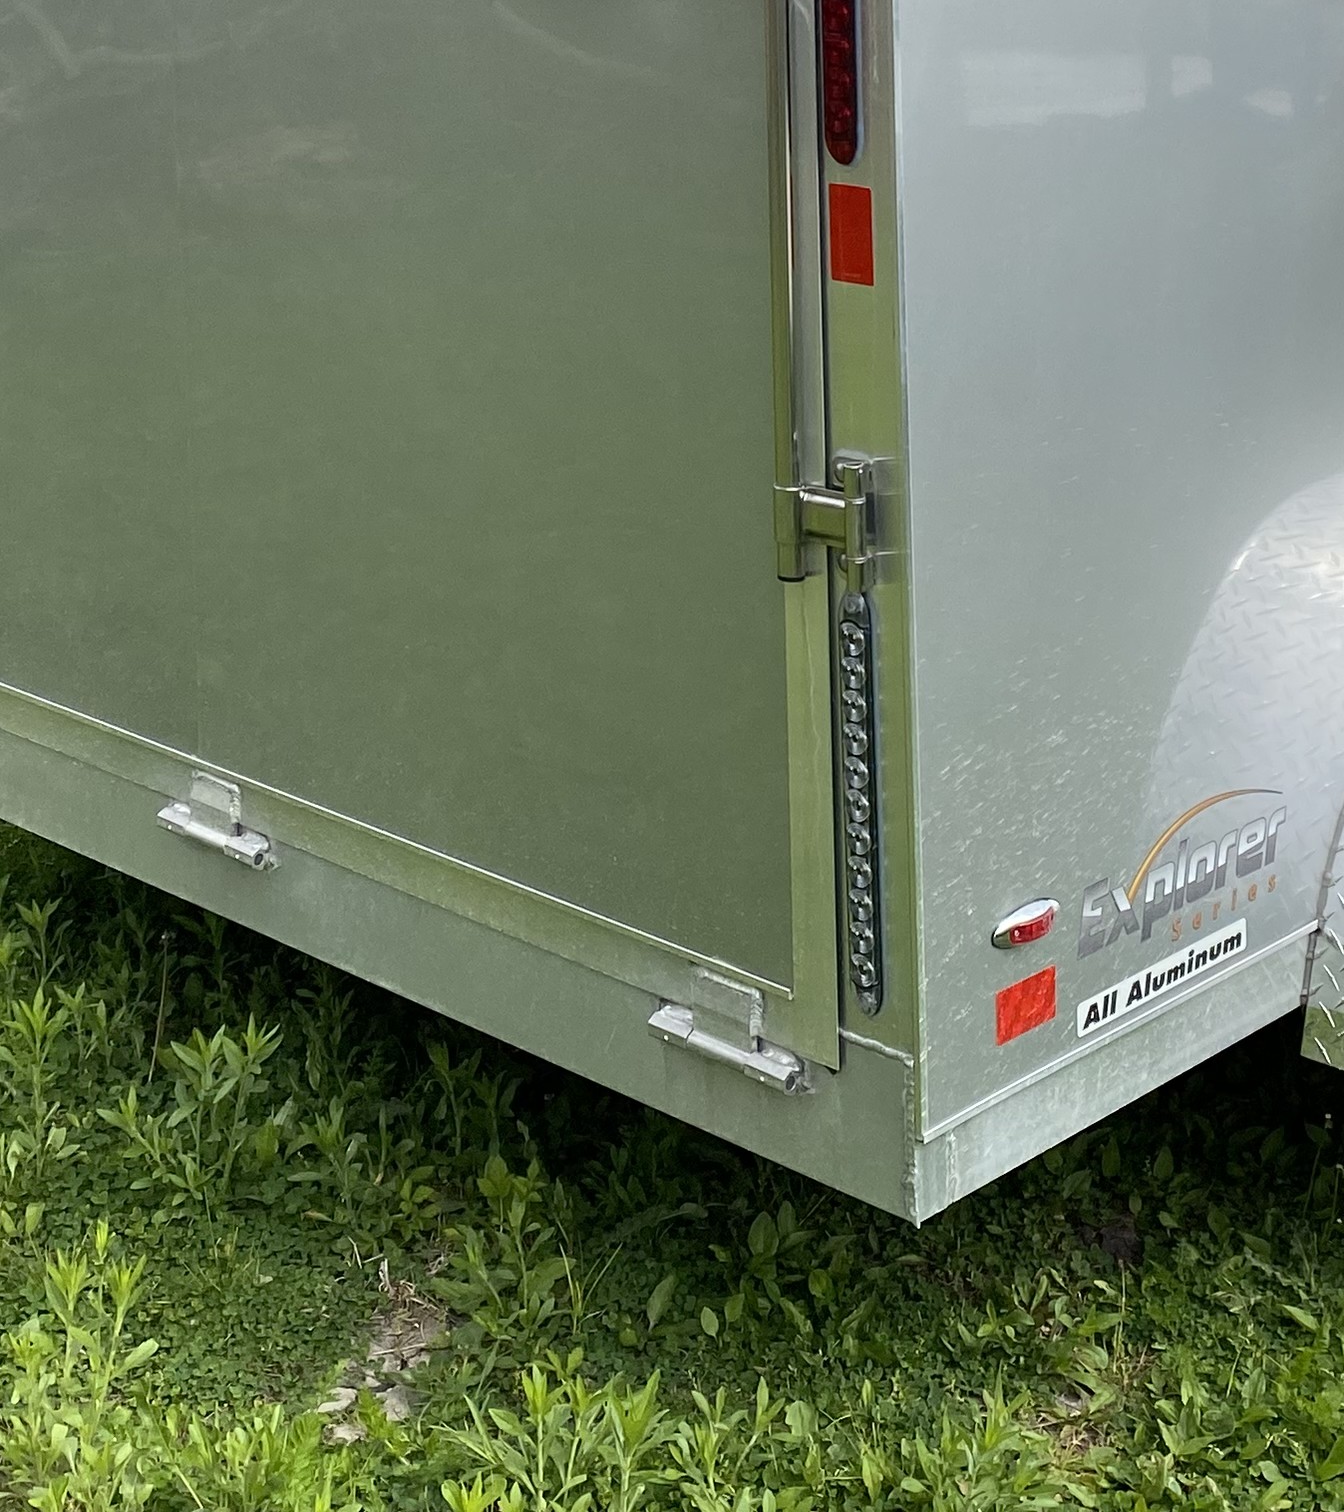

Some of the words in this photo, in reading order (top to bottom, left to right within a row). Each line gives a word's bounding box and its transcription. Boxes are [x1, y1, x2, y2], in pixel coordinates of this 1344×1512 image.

[1076, 805, 1288, 961] Explorer
[1170, 873, 1279, 942] series
[1082, 989, 1118, 1031] All
[1125, 930, 1243, 1008] Aluminum
